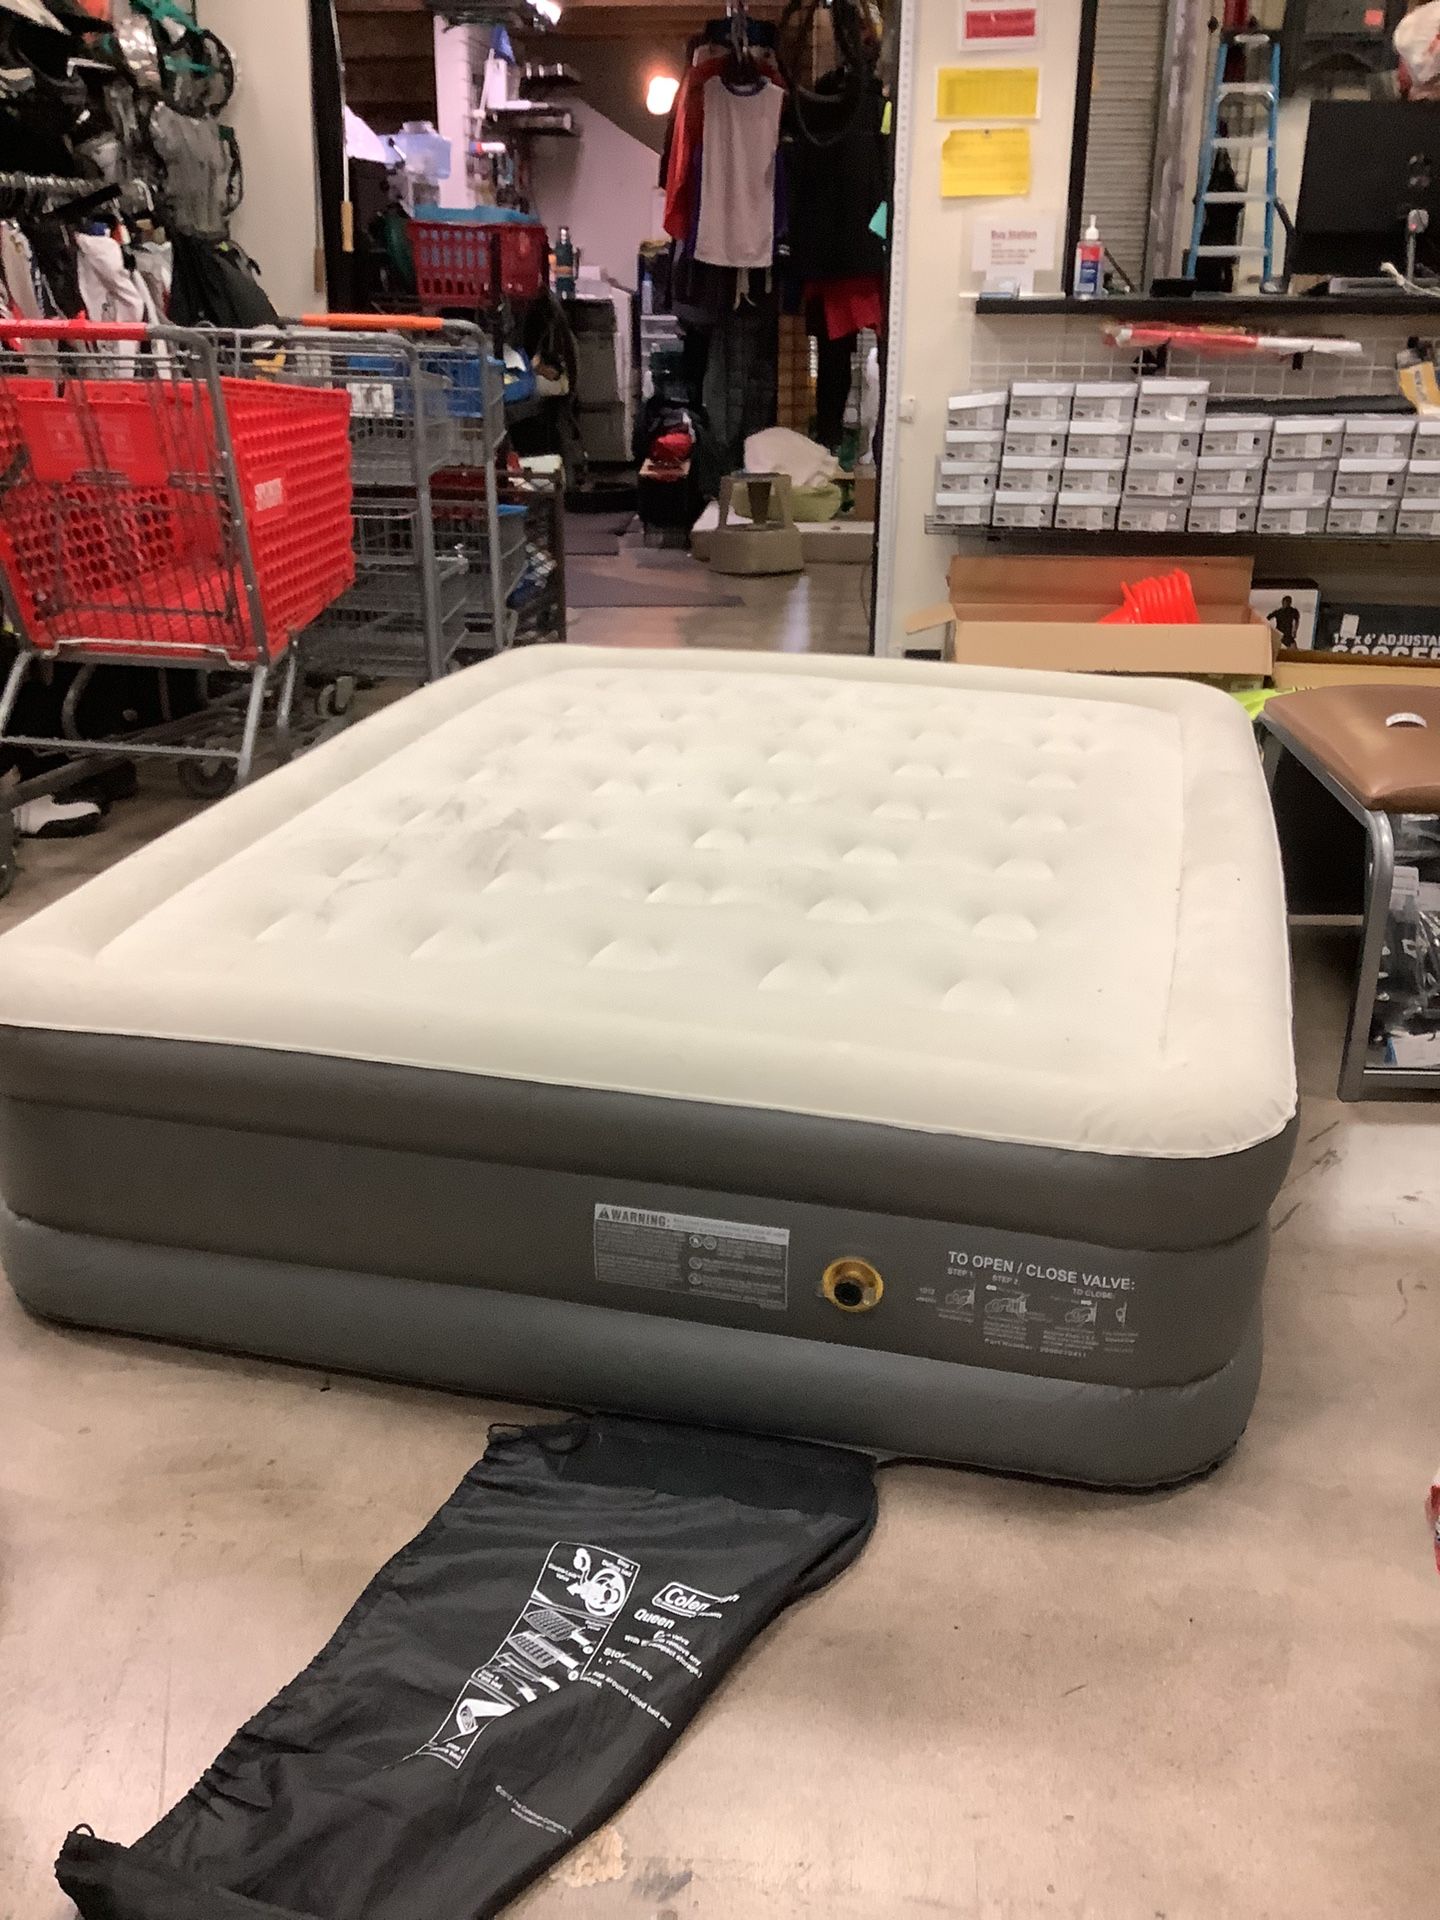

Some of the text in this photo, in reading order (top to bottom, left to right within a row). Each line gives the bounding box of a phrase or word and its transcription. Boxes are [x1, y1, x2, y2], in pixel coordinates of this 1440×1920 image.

[948, 1251, 969, 1266] TO
[972, 1255, 1014, 1274] OPEN
[1025, 1264, 1078, 1284] CLOSE
[1081, 1272, 1136, 1291] VALVE:
[634, 1609, 675, 1629] Queen
